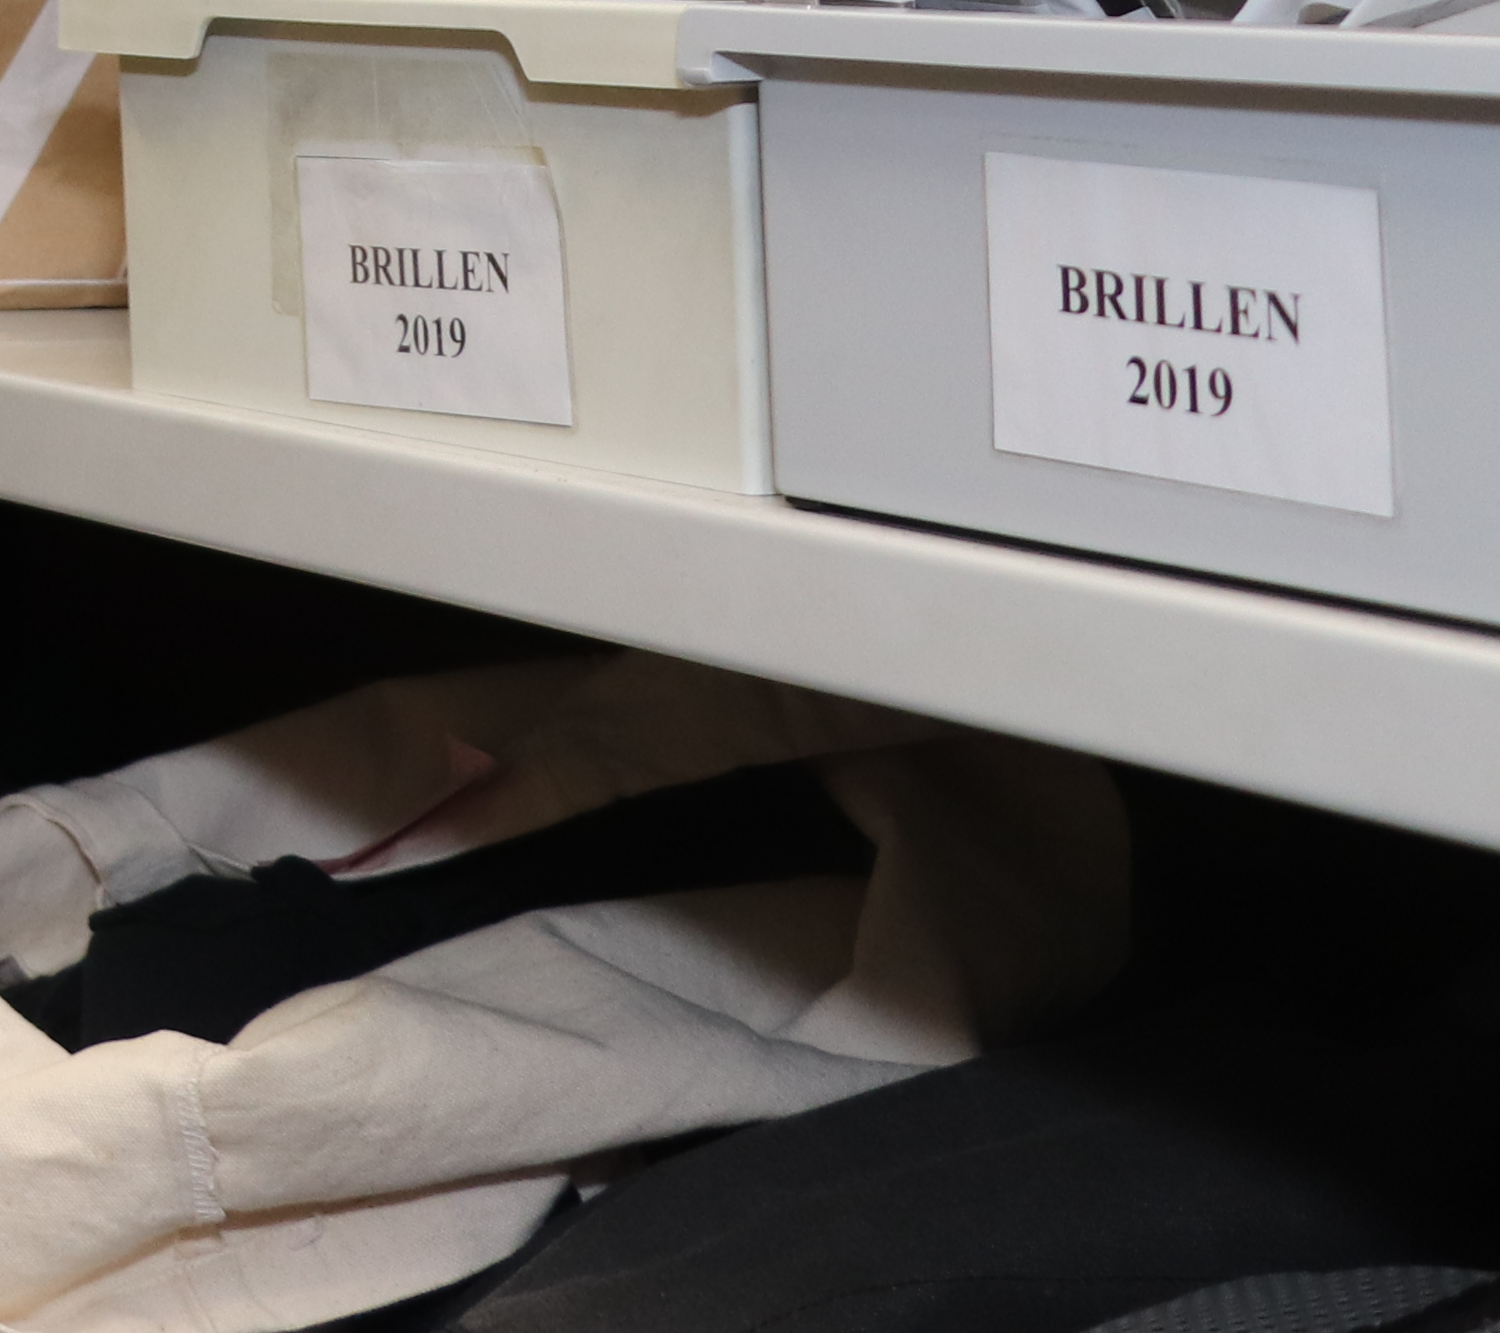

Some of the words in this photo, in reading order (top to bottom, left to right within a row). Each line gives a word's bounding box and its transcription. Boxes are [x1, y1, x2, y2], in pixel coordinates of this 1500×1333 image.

[348, 243, 512, 295] BRILLEN
[1057, 263, 1304, 348] BRILLEN
[395, 313, 467, 360] 2019
[1125, 355, 1235, 418] 2019
